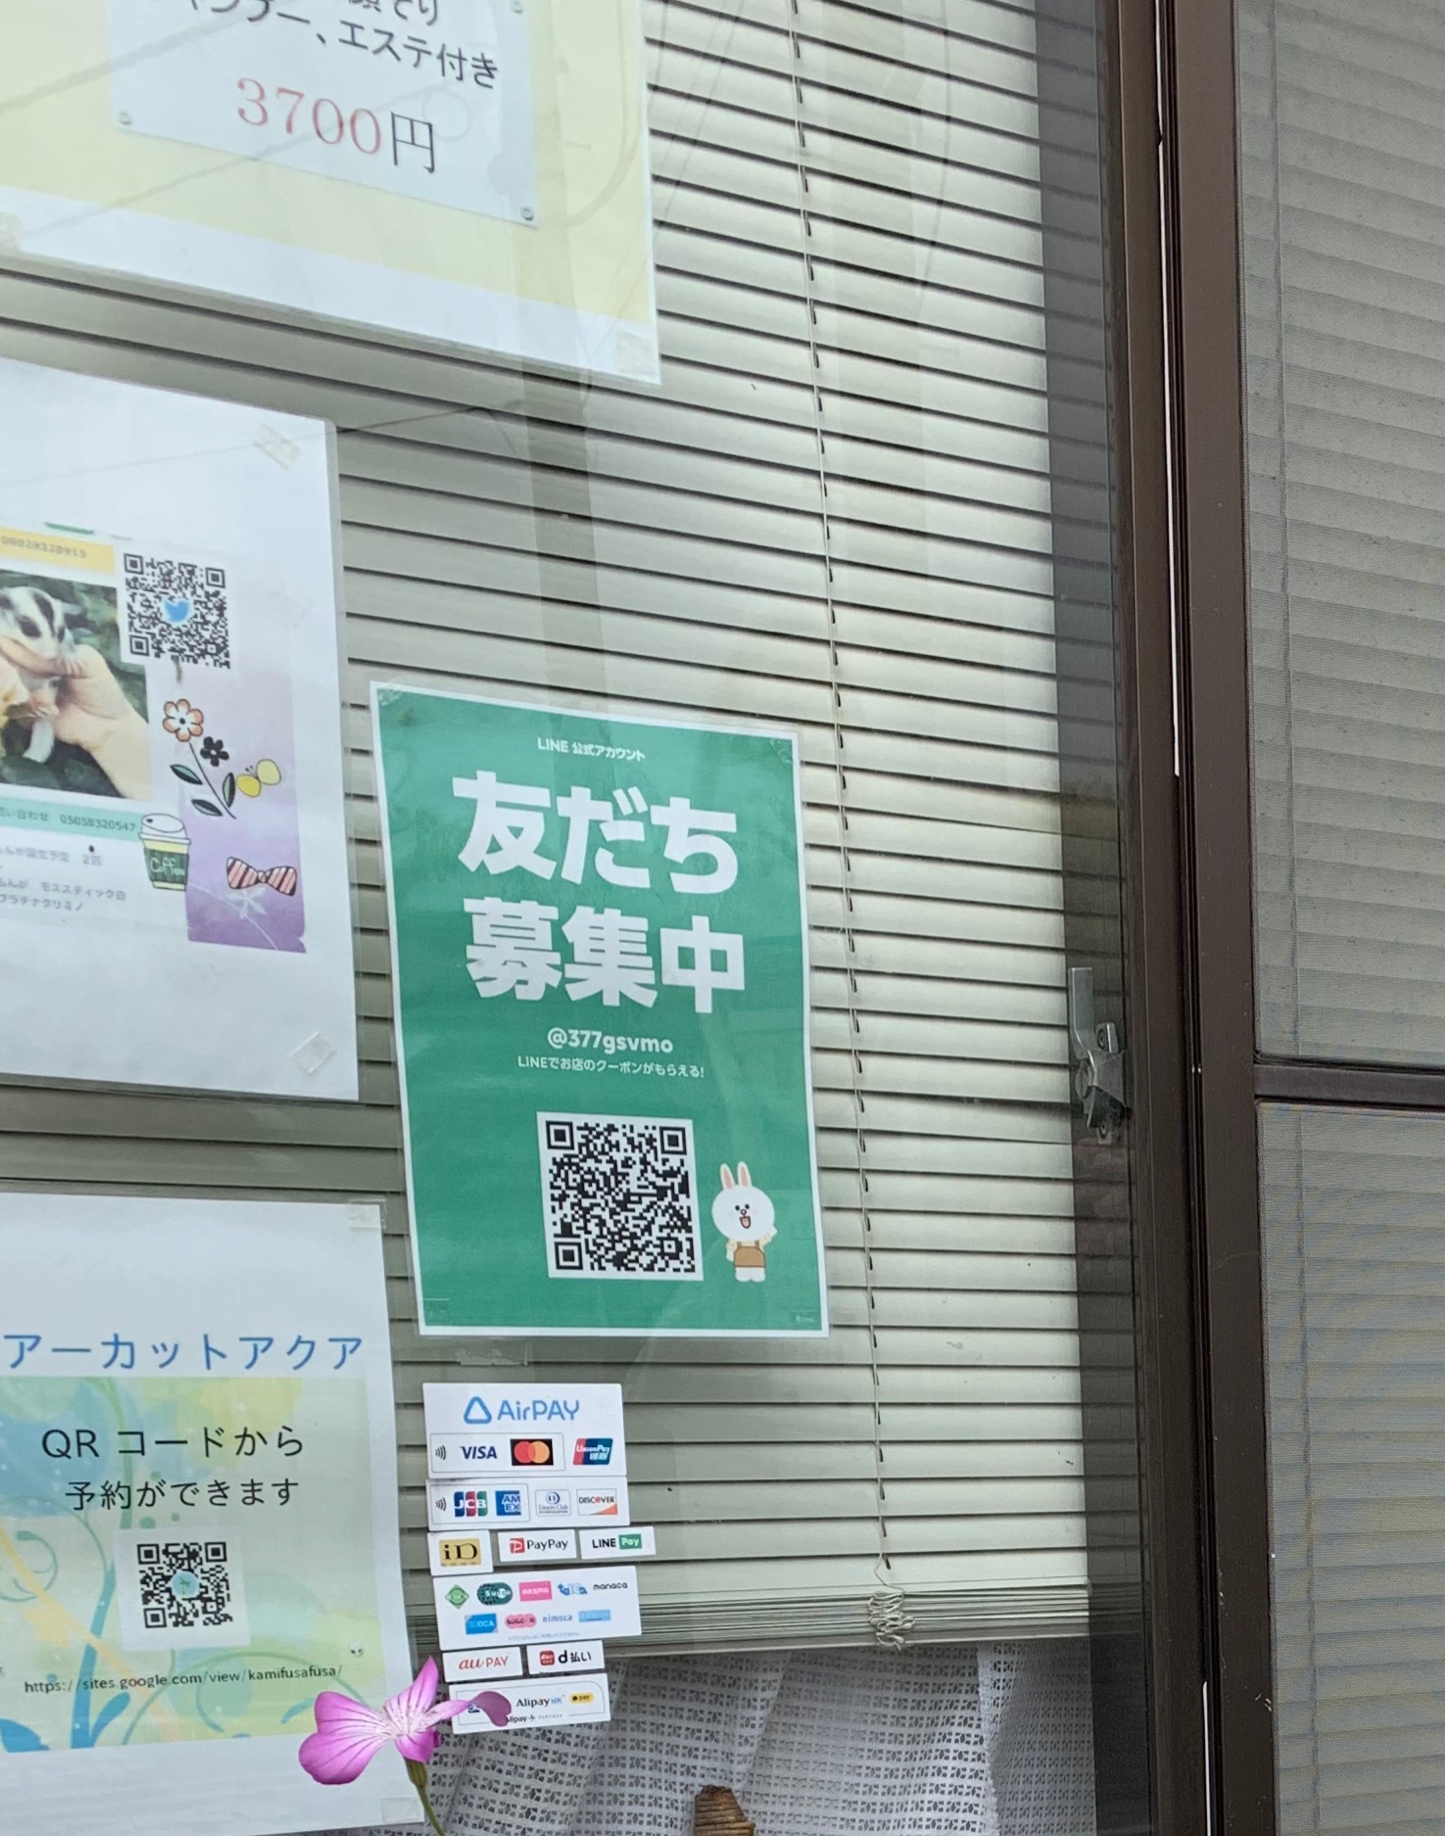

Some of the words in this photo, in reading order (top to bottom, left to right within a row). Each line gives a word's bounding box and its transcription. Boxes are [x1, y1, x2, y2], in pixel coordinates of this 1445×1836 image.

[237, 77, 435, 174] 3700円
[537, 737, 569, 753] LINE
[571, 742, 646, 762] 公式アカウント
[451, 770, 739, 894] 友だち
[463, 896, 746, 1014] 募集中
[547, 1027, 674, 1055] @377gsvmo
[517, 1055, 705, 1079] LINEでお店のクーポンがもらえる!
[3, 1333, 363, 1371] アーカットアクア
[497, 1399, 580, 1421] AirPAY
[41, 1429, 99, 1459] QR
[117, 1425, 303, 1458] コードから
[460, 1445, 498, 1460] VISA
[65, 1478, 299, 1511] 予約ができます
[454, 1499, 488, 1509] JCB
[578, 1495, 615, 1504] DISCOVER
[443, 1543, 478, 1560] iD
[527, 1538, 568, 1551] PayPay
[592, 1537, 616, 1549] LINE
[621, 1536, 639, 1547] Pay
[593, 1582, 628, 1590] manaca
[542, 1613, 573, 1623] nimoca
